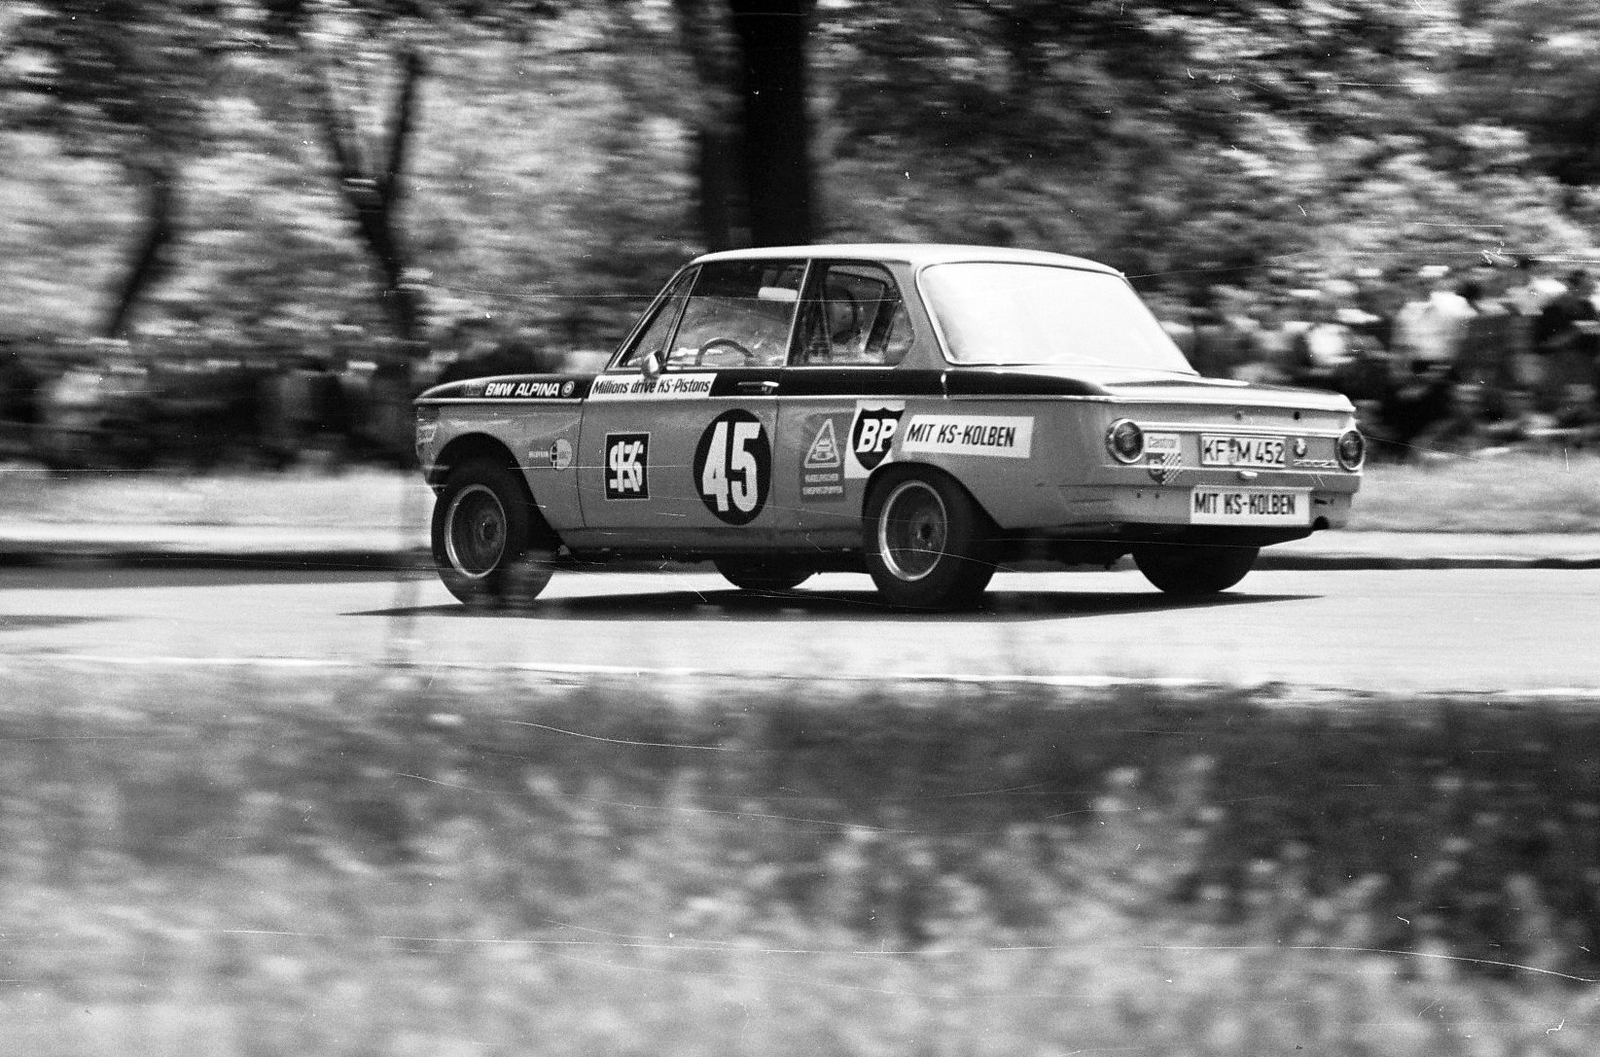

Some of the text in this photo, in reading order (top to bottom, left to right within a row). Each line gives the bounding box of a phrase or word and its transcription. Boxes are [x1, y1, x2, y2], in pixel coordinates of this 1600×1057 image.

[485, 382, 515, 397] BMW
[514, 382, 560, 396] ALPINA
[592, 377, 711, 395] Millions drive KS-Pistons
[855, 418, 899, 453] BP
[906, 423, 1017, 448] MIT KS-KOLBEN
[1255, 441, 1284, 464] 452
[702, 421, 761, 513] 45
[1194, 492, 1296, 515] MIT KS-KOLBEN
